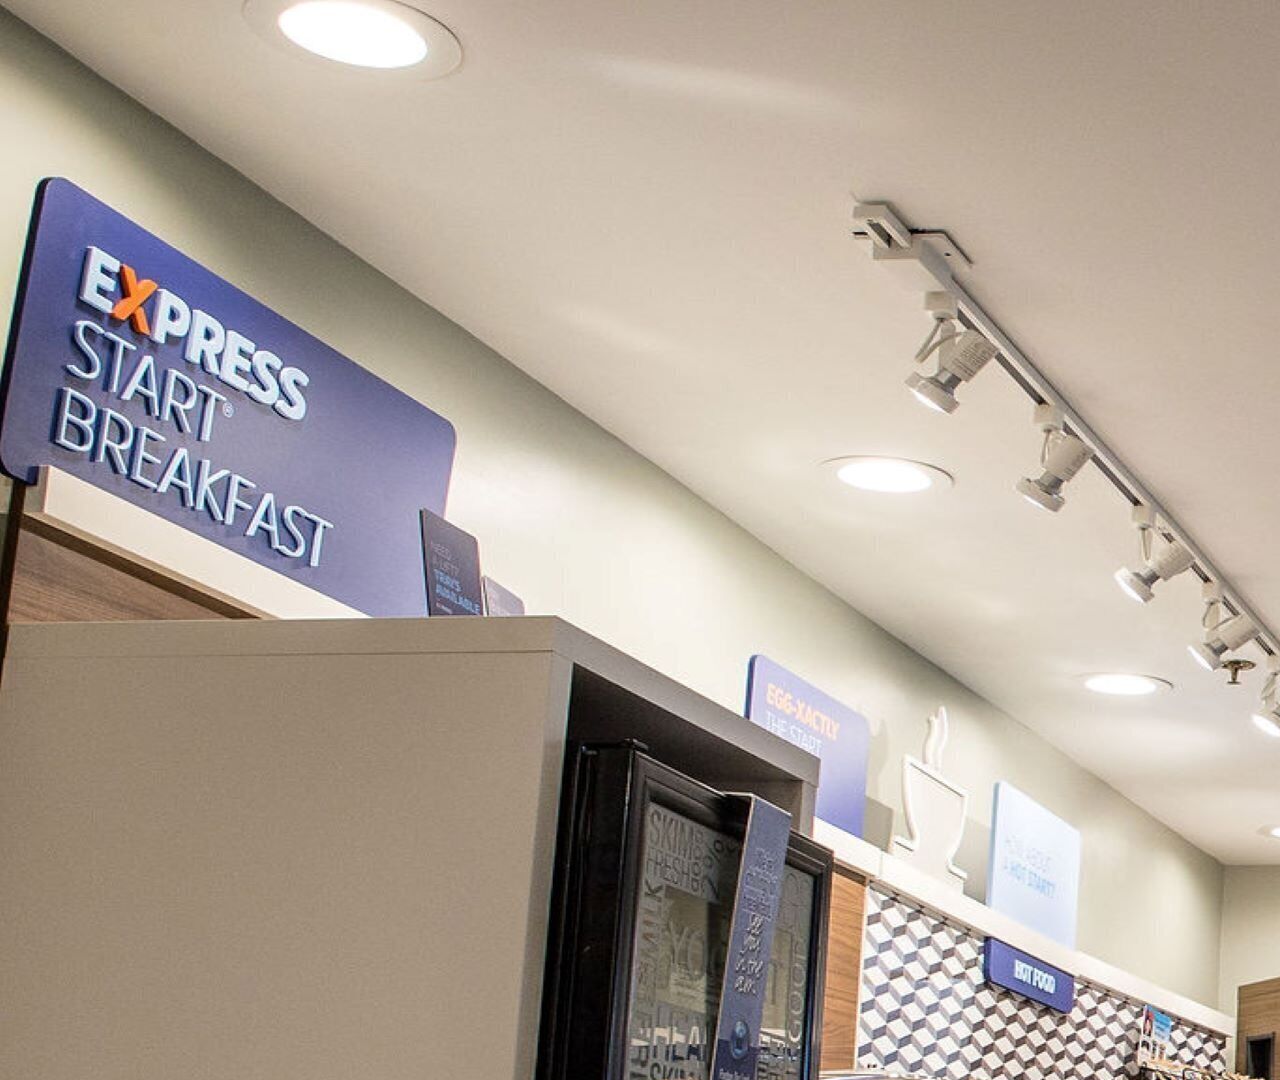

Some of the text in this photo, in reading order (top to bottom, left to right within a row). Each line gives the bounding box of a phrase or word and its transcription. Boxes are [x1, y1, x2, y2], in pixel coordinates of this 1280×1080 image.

[80, 246, 309, 420] EXPRESS
[50, 387, 334, 567] BREAKFAST
[766, 682, 840, 741] EGG-XACTLY
[790, 724, 824, 756] START
[1014, 959, 1056, 994] HOT FOOD
